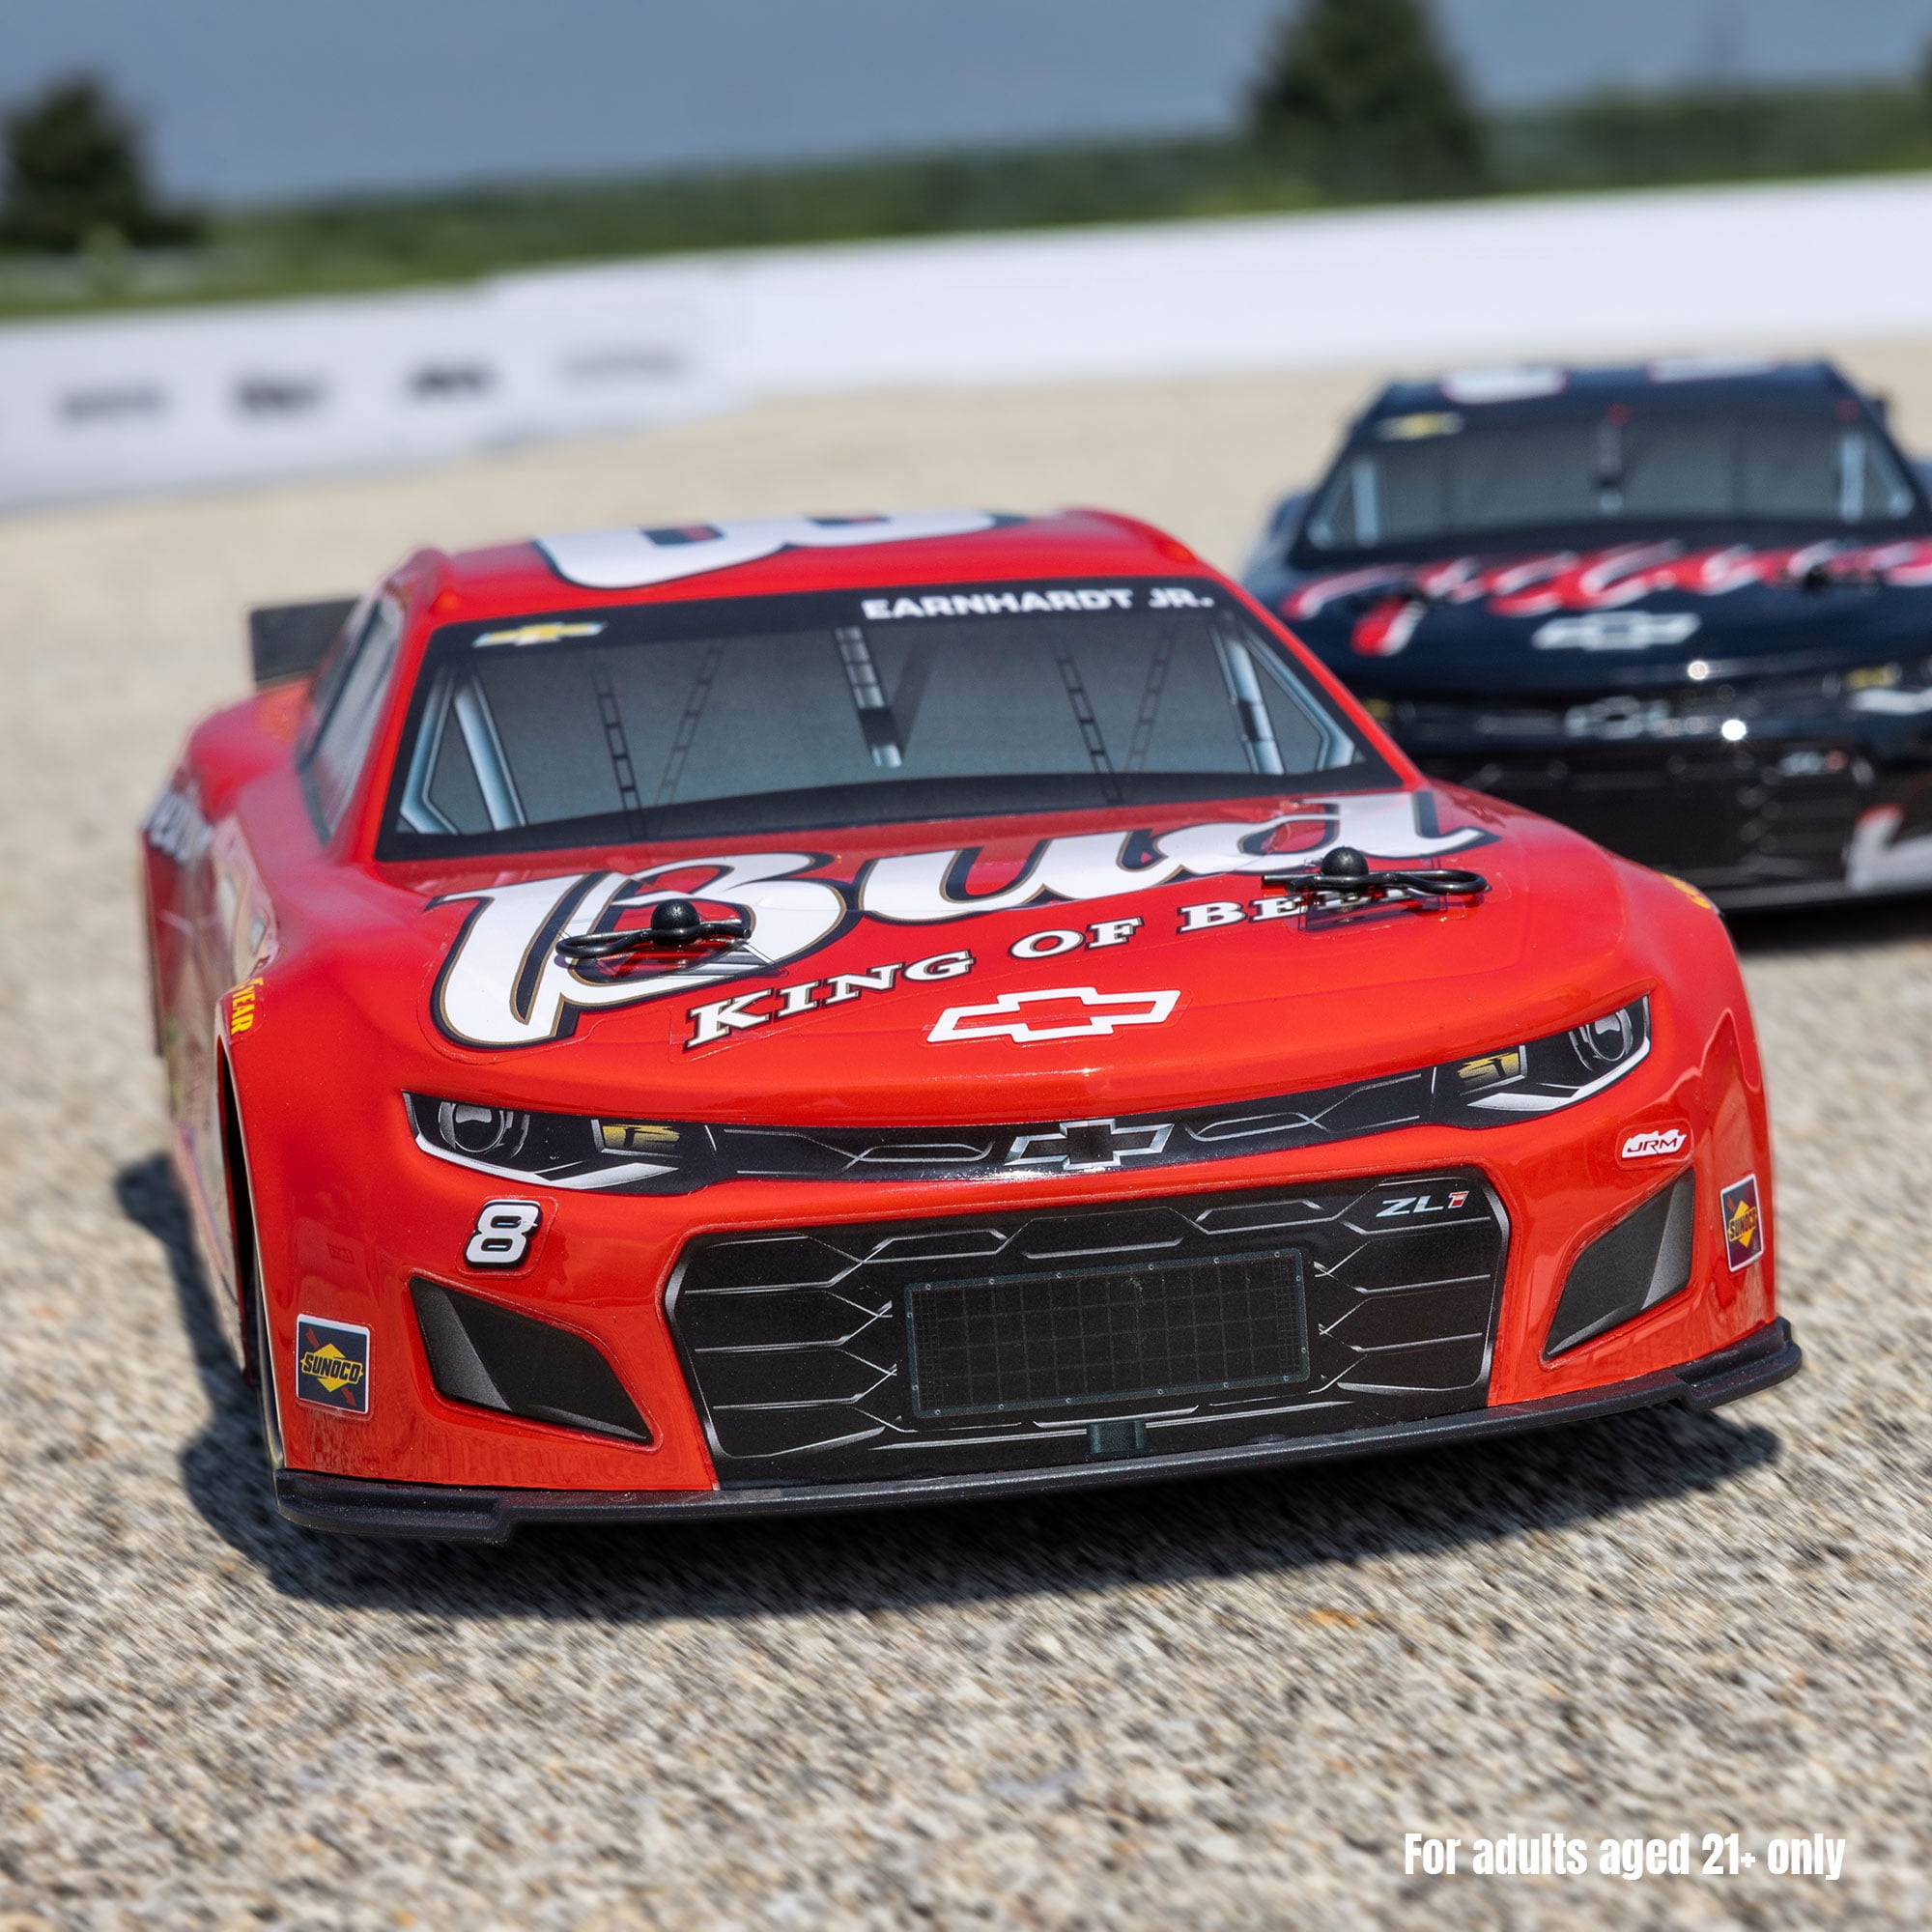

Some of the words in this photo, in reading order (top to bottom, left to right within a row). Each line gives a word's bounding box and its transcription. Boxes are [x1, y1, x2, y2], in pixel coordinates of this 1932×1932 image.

[862, 588, 1133, 619] EARNHARDT
[1148, 587, 1214, 609] JR.
[426, 791, 1500, 1049] Bud
[683, 949, 976, 1051] KING
[1009, 915, 1144, 959] OF
[1627, 1137, 1678, 1154] JRM
[1376, 1191, 1469, 1217] ZL1
[464, 1199, 543, 1268] 8
[301, 1353, 362, 1383] SUNOCO
